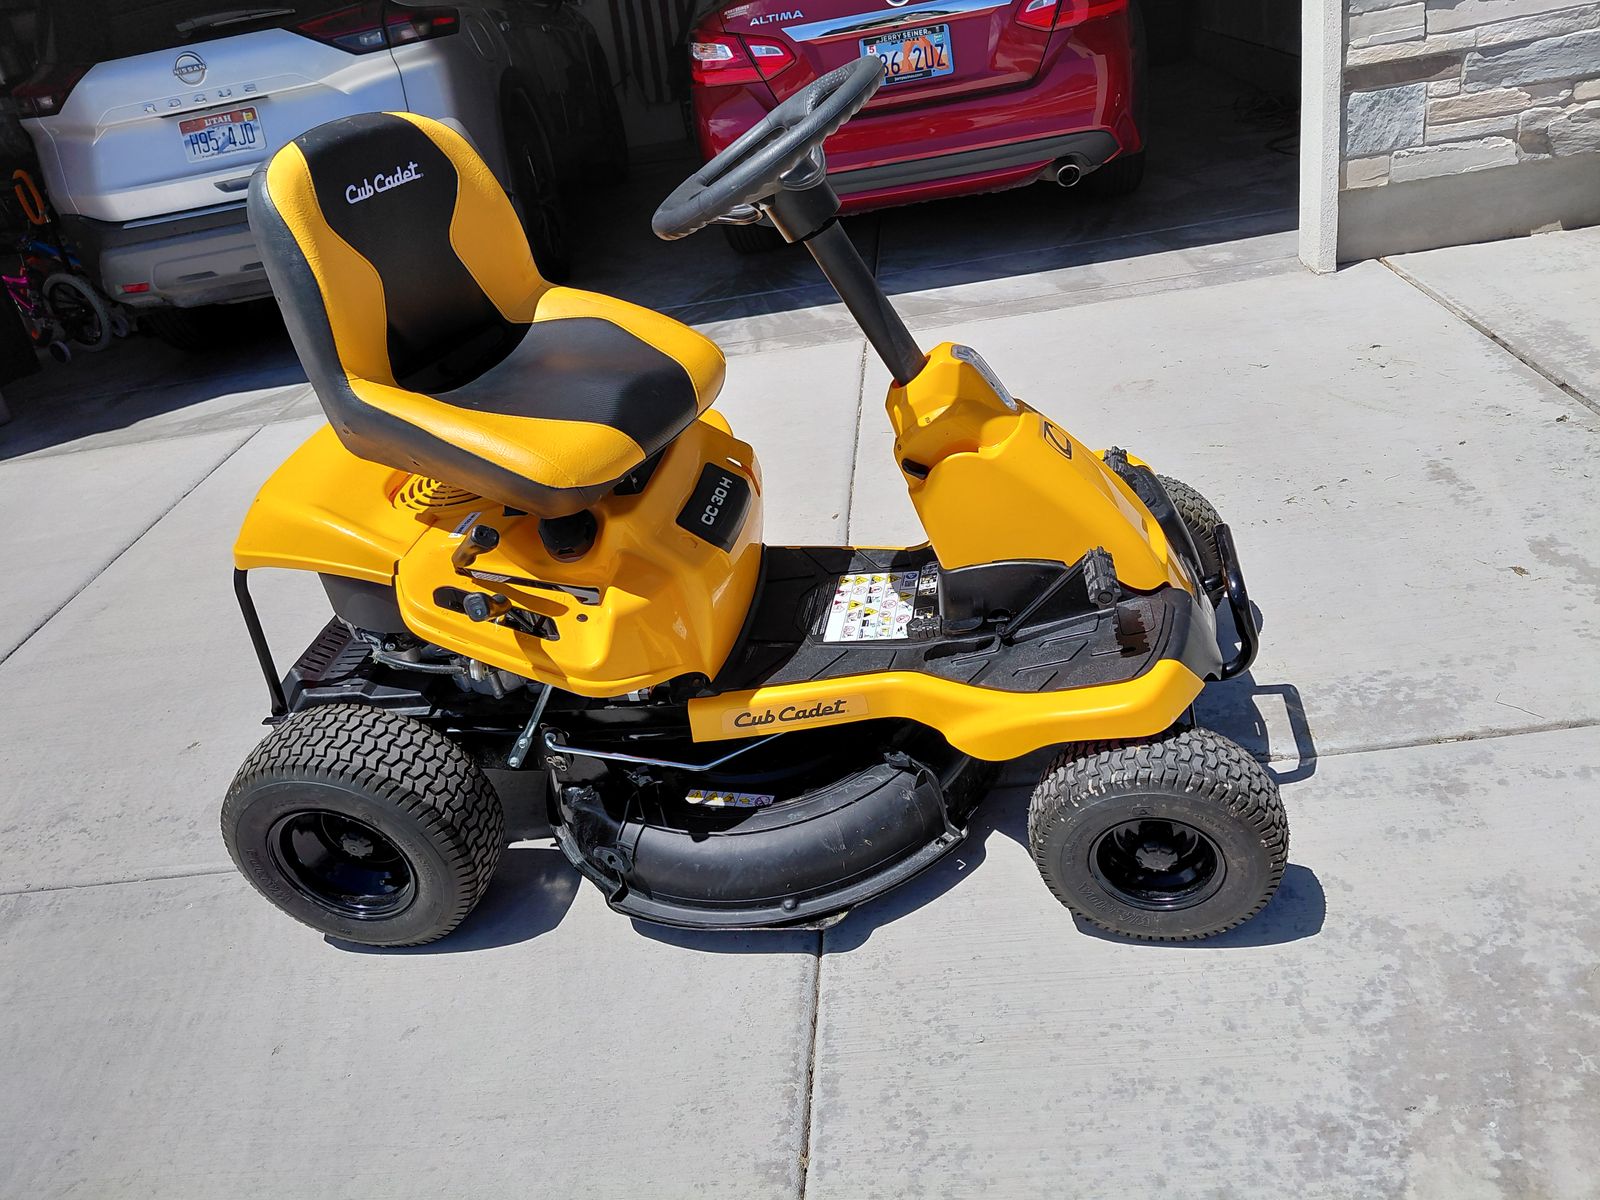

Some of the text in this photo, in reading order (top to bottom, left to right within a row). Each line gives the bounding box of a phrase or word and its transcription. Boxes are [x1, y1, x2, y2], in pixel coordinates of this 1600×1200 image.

[750, 10, 804, 27] ALTIMA
[880, 33, 902, 43] JERRY
[902, 28, 928, 39] SEINER
[868, 45, 876, 54] 5
[913, 43, 946, 72] 2UZ
[173, 63, 207, 76] NISSAN
[143, 83, 257, 113] ROGUE
[204, 114, 232, 127] UTAH
[189, 130, 220, 155] H95
[228, 122, 256, 147] 4JD
[345, 161, 421, 204] Cub Cadet
[701, 505, 719, 526] CC
[734, 699, 847, 728] Cub Cadet
